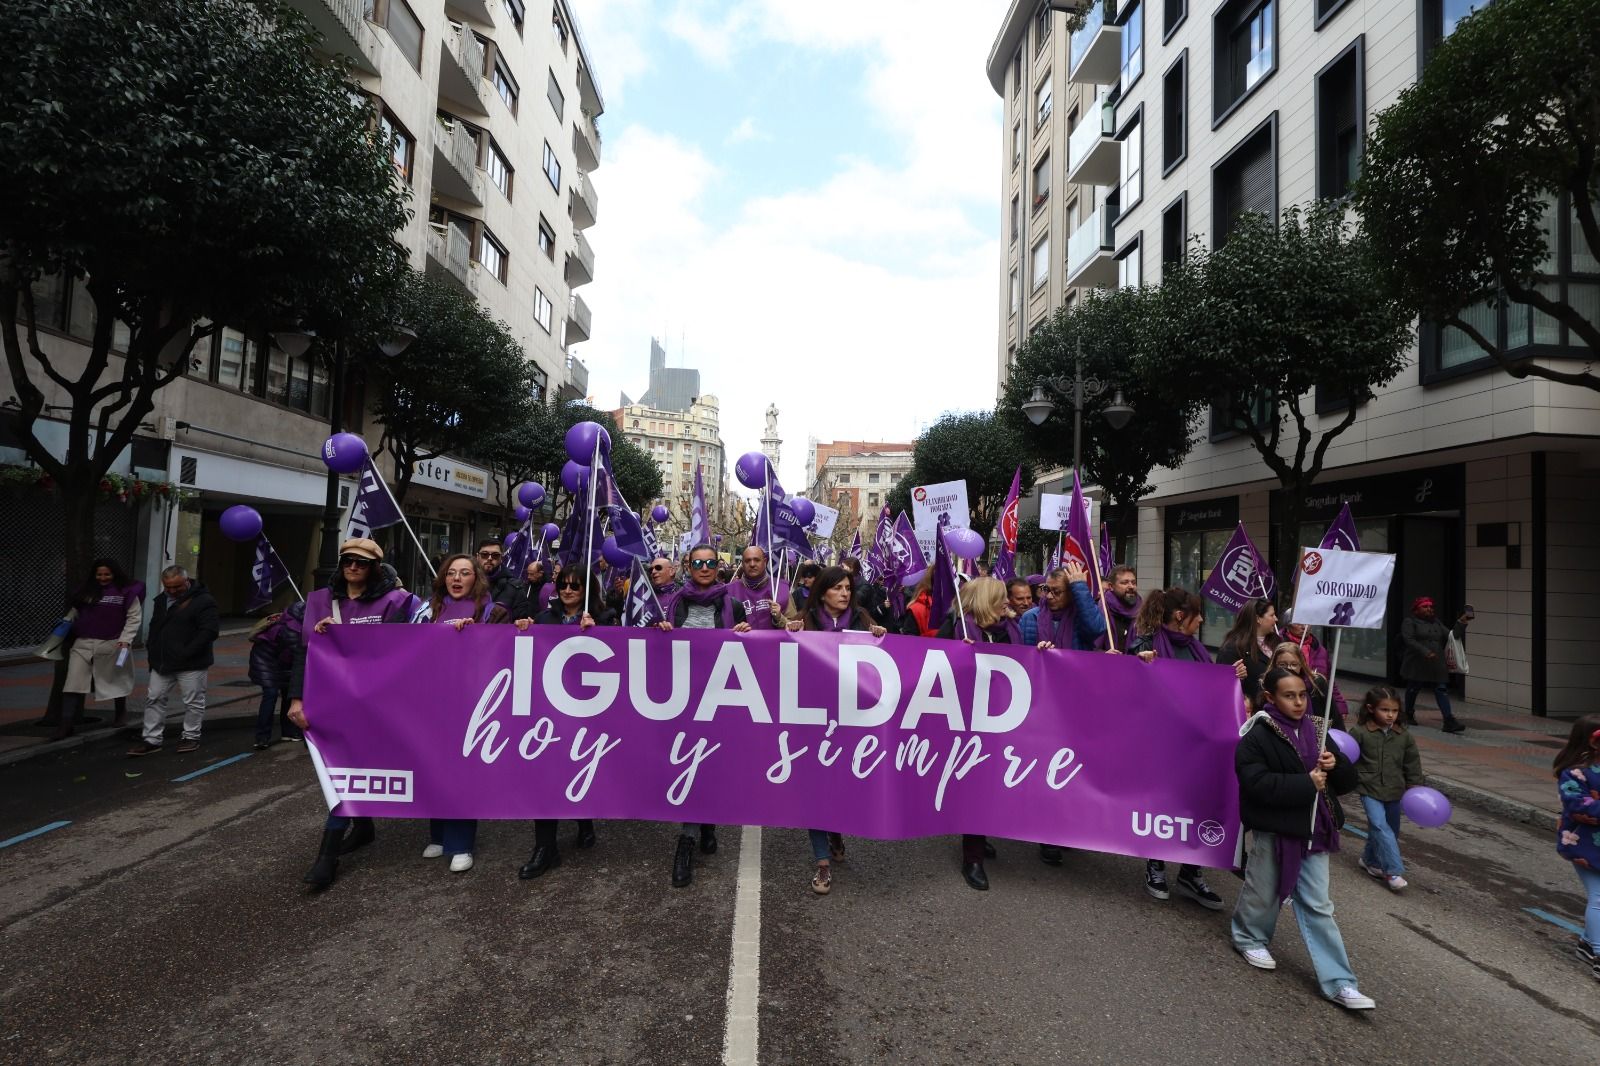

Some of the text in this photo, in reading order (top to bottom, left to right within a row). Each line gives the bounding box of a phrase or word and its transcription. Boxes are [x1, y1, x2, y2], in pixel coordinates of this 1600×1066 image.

[1315, 580, 1377, 599] SORORIDAD
[512, 636, 1032, 733] IGUALDAD
[463, 668, 1083, 812] hoy y siempre
[1131, 811, 1194, 842] UGT
